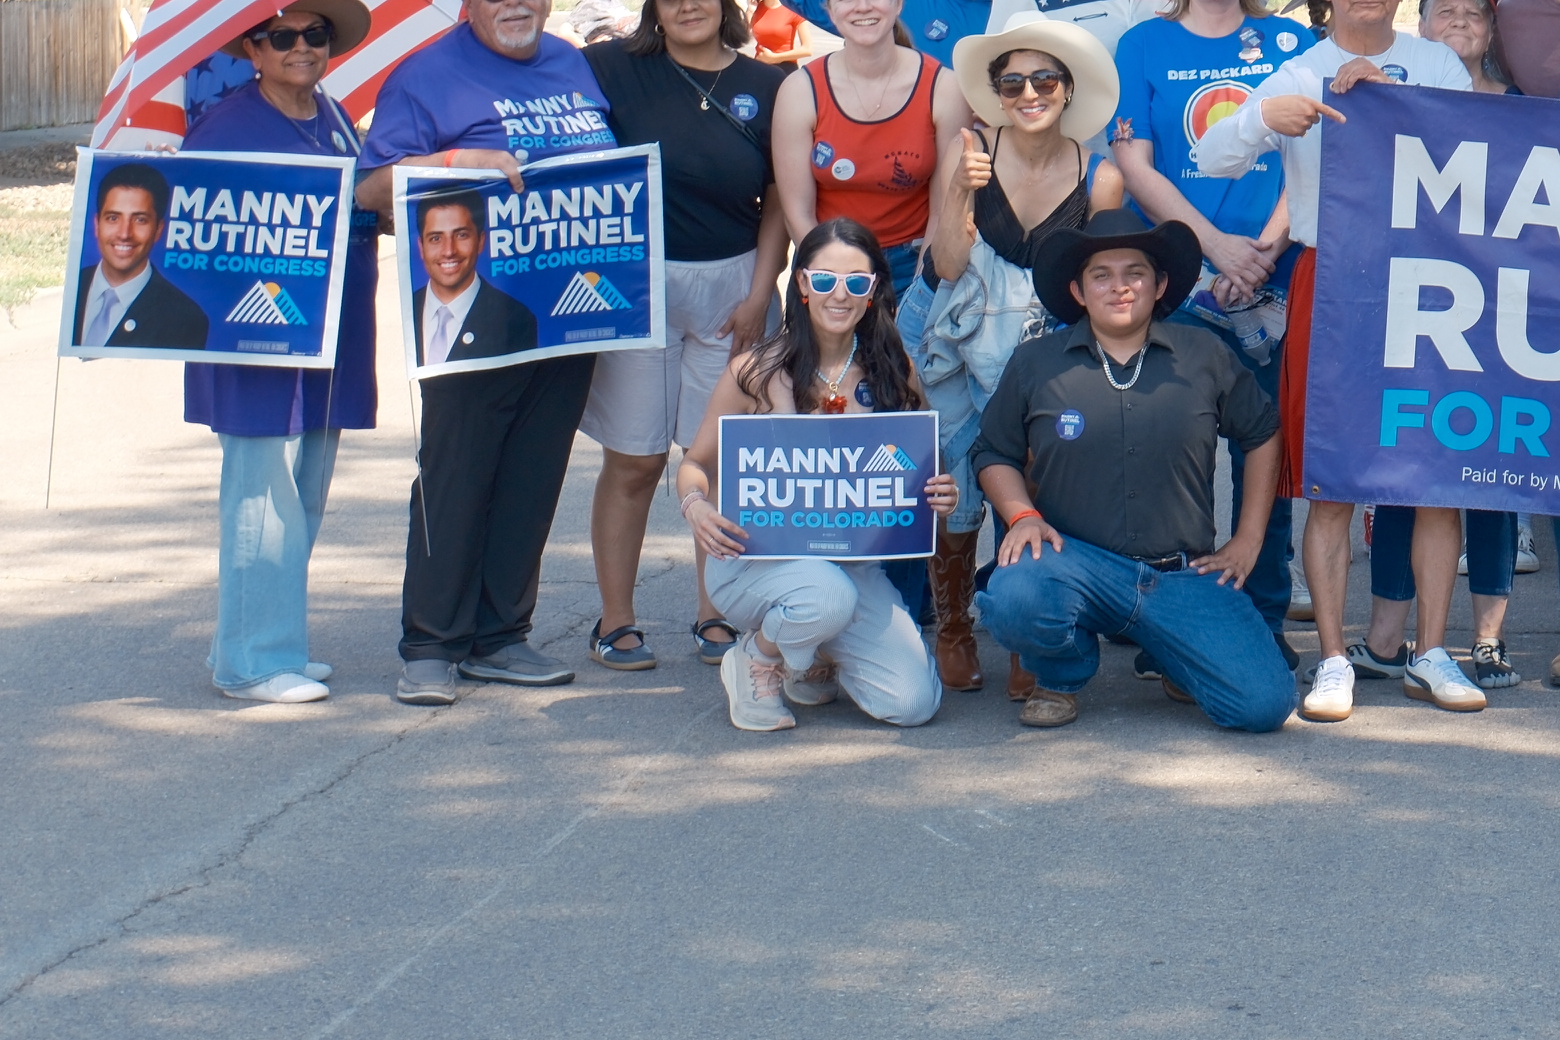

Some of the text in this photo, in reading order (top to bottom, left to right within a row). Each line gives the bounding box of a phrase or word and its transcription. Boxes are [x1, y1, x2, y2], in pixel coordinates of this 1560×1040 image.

[1167, 63, 1274, 80] DEZ PACKARD
[508, 131, 615, 149] FOR CONGRES
[169, 186, 335, 228] MANNY
[488, 182, 644, 228] MANNY
[166, 220, 329, 258] RUTINEL
[490, 216, 644, 258] RUTINEL
[163, 252, 327, 277] FOR CONGRESS
[491, 245, 645, 277] FOR CONGRESS
[1378, 388, 1552, 458] FOR
[739, 446, 864, 473] MANNY
[738, 477, 918, 508] RUTINEL
[1462, 467, 1497, 483] Paid
[1503, 470, 1525, 486] for
[1530, 472, 1549, 490] by
[739, 509, 915, 528] FOR COLORADO
